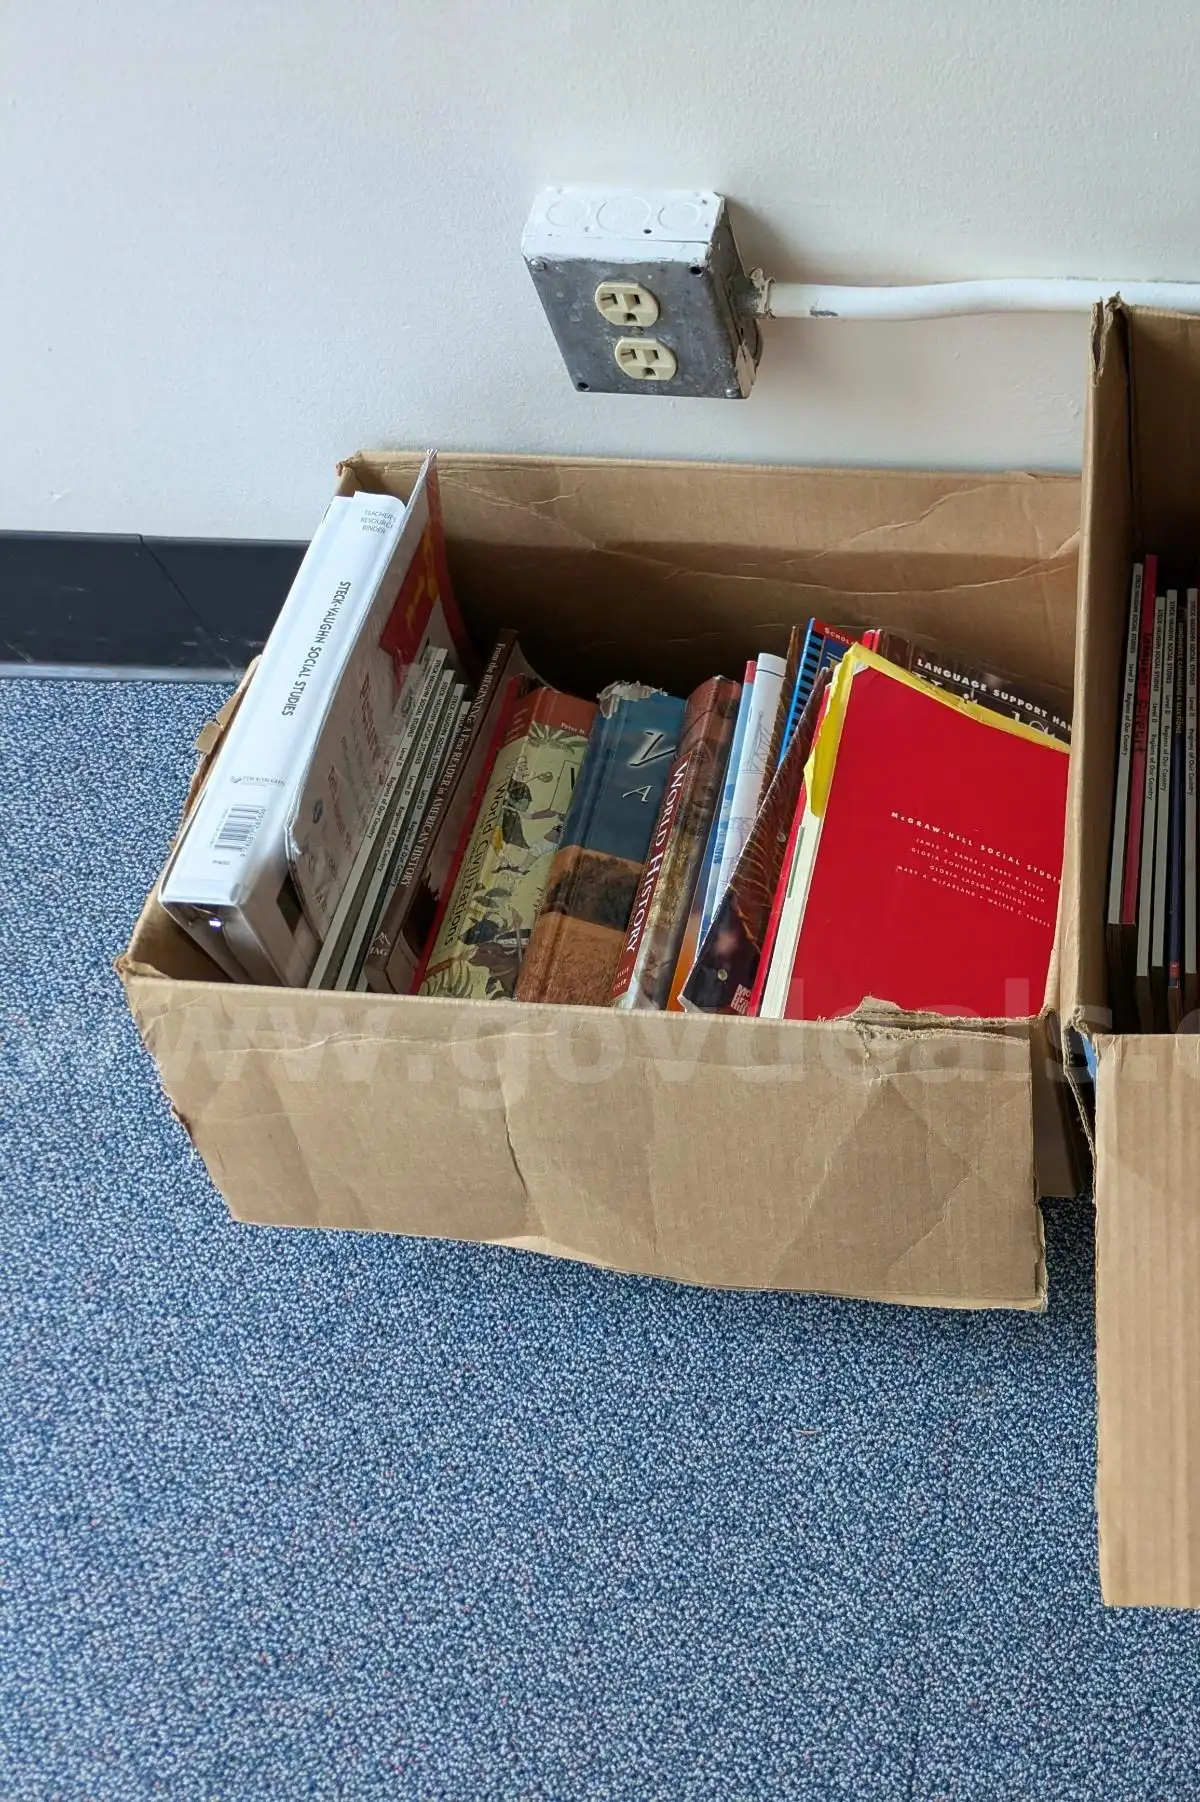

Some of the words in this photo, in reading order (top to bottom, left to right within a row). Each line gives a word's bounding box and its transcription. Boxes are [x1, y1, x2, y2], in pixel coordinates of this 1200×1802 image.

[316, 579, 352, 645] STECK-VAUGHN
[298, 645, 322, 677] SOCIAL
[486, 658, 497, 673] the
[491, 640, 505, 659] From
[281, 680, 307, 717] STUDIES
[917, 658, 987, 691] LANGUAGE
[993, 688, 1048, 718] SUPPORT
[421, 723, 434, 743] SOCIAL
[454, 732, 467, 751] First
[413, 743, 427, 765] STUDIES
[440, 750, 461, 786] READER
[405, 774, 415, 789] Level
[391, 805, 404, 828] Regions
[417, 794, 443, 844] AMERICAN
[481, 782, 508, 837] World
[655, 762, 688, 848] WORLD
[891, 811, 973, 846] McGRAW-HILL
[980, 844, 1020, 866] SOCIAL
[916, 838, 940, 850] JAMES
[954, 852, 978, 865] BANKS
[375, 848, 390, 873] Country
[399, 844, 423, 888] HISTORY
[911, 847, 940, 861] GLORIA
[944, 859, 986, 879] CONTRERAS
[929, 865, 958, 879] GLORIA
[444, 839, 488, 947] Civilizations
[627, 852, 663, 954] HISTORY
[896, 865, 918, 876] MARY
[932, 877, 976, 897] McFARLAND
[988, 898, 1014, 912] WALTER
